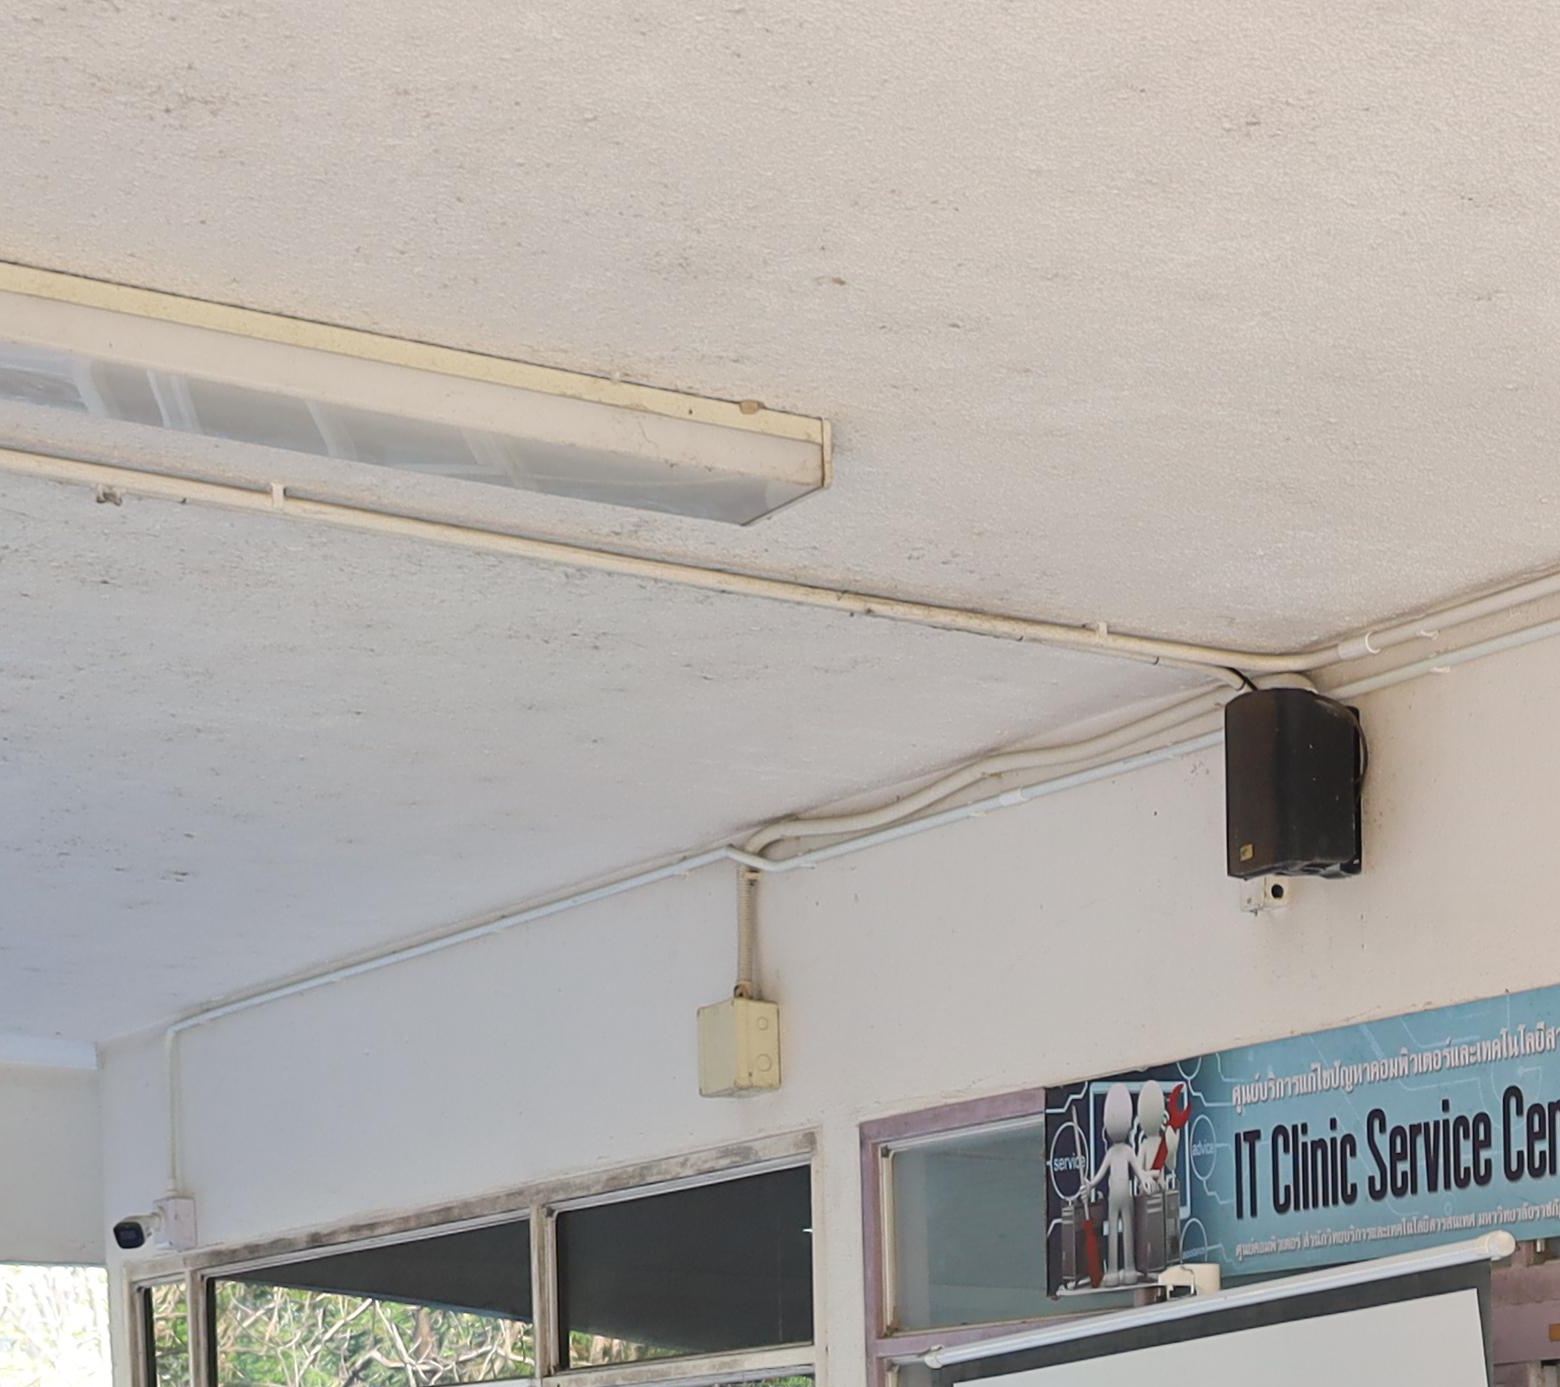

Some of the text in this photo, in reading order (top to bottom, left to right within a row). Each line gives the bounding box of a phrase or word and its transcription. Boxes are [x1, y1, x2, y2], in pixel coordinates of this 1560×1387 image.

[1053, 1152, 1086, 1172] service
[1234, 1129, 1258, 1220] IT
[1271, 1117, 1358, 1215] Clinic
[1366, 1099, 1493, 1201] Service
